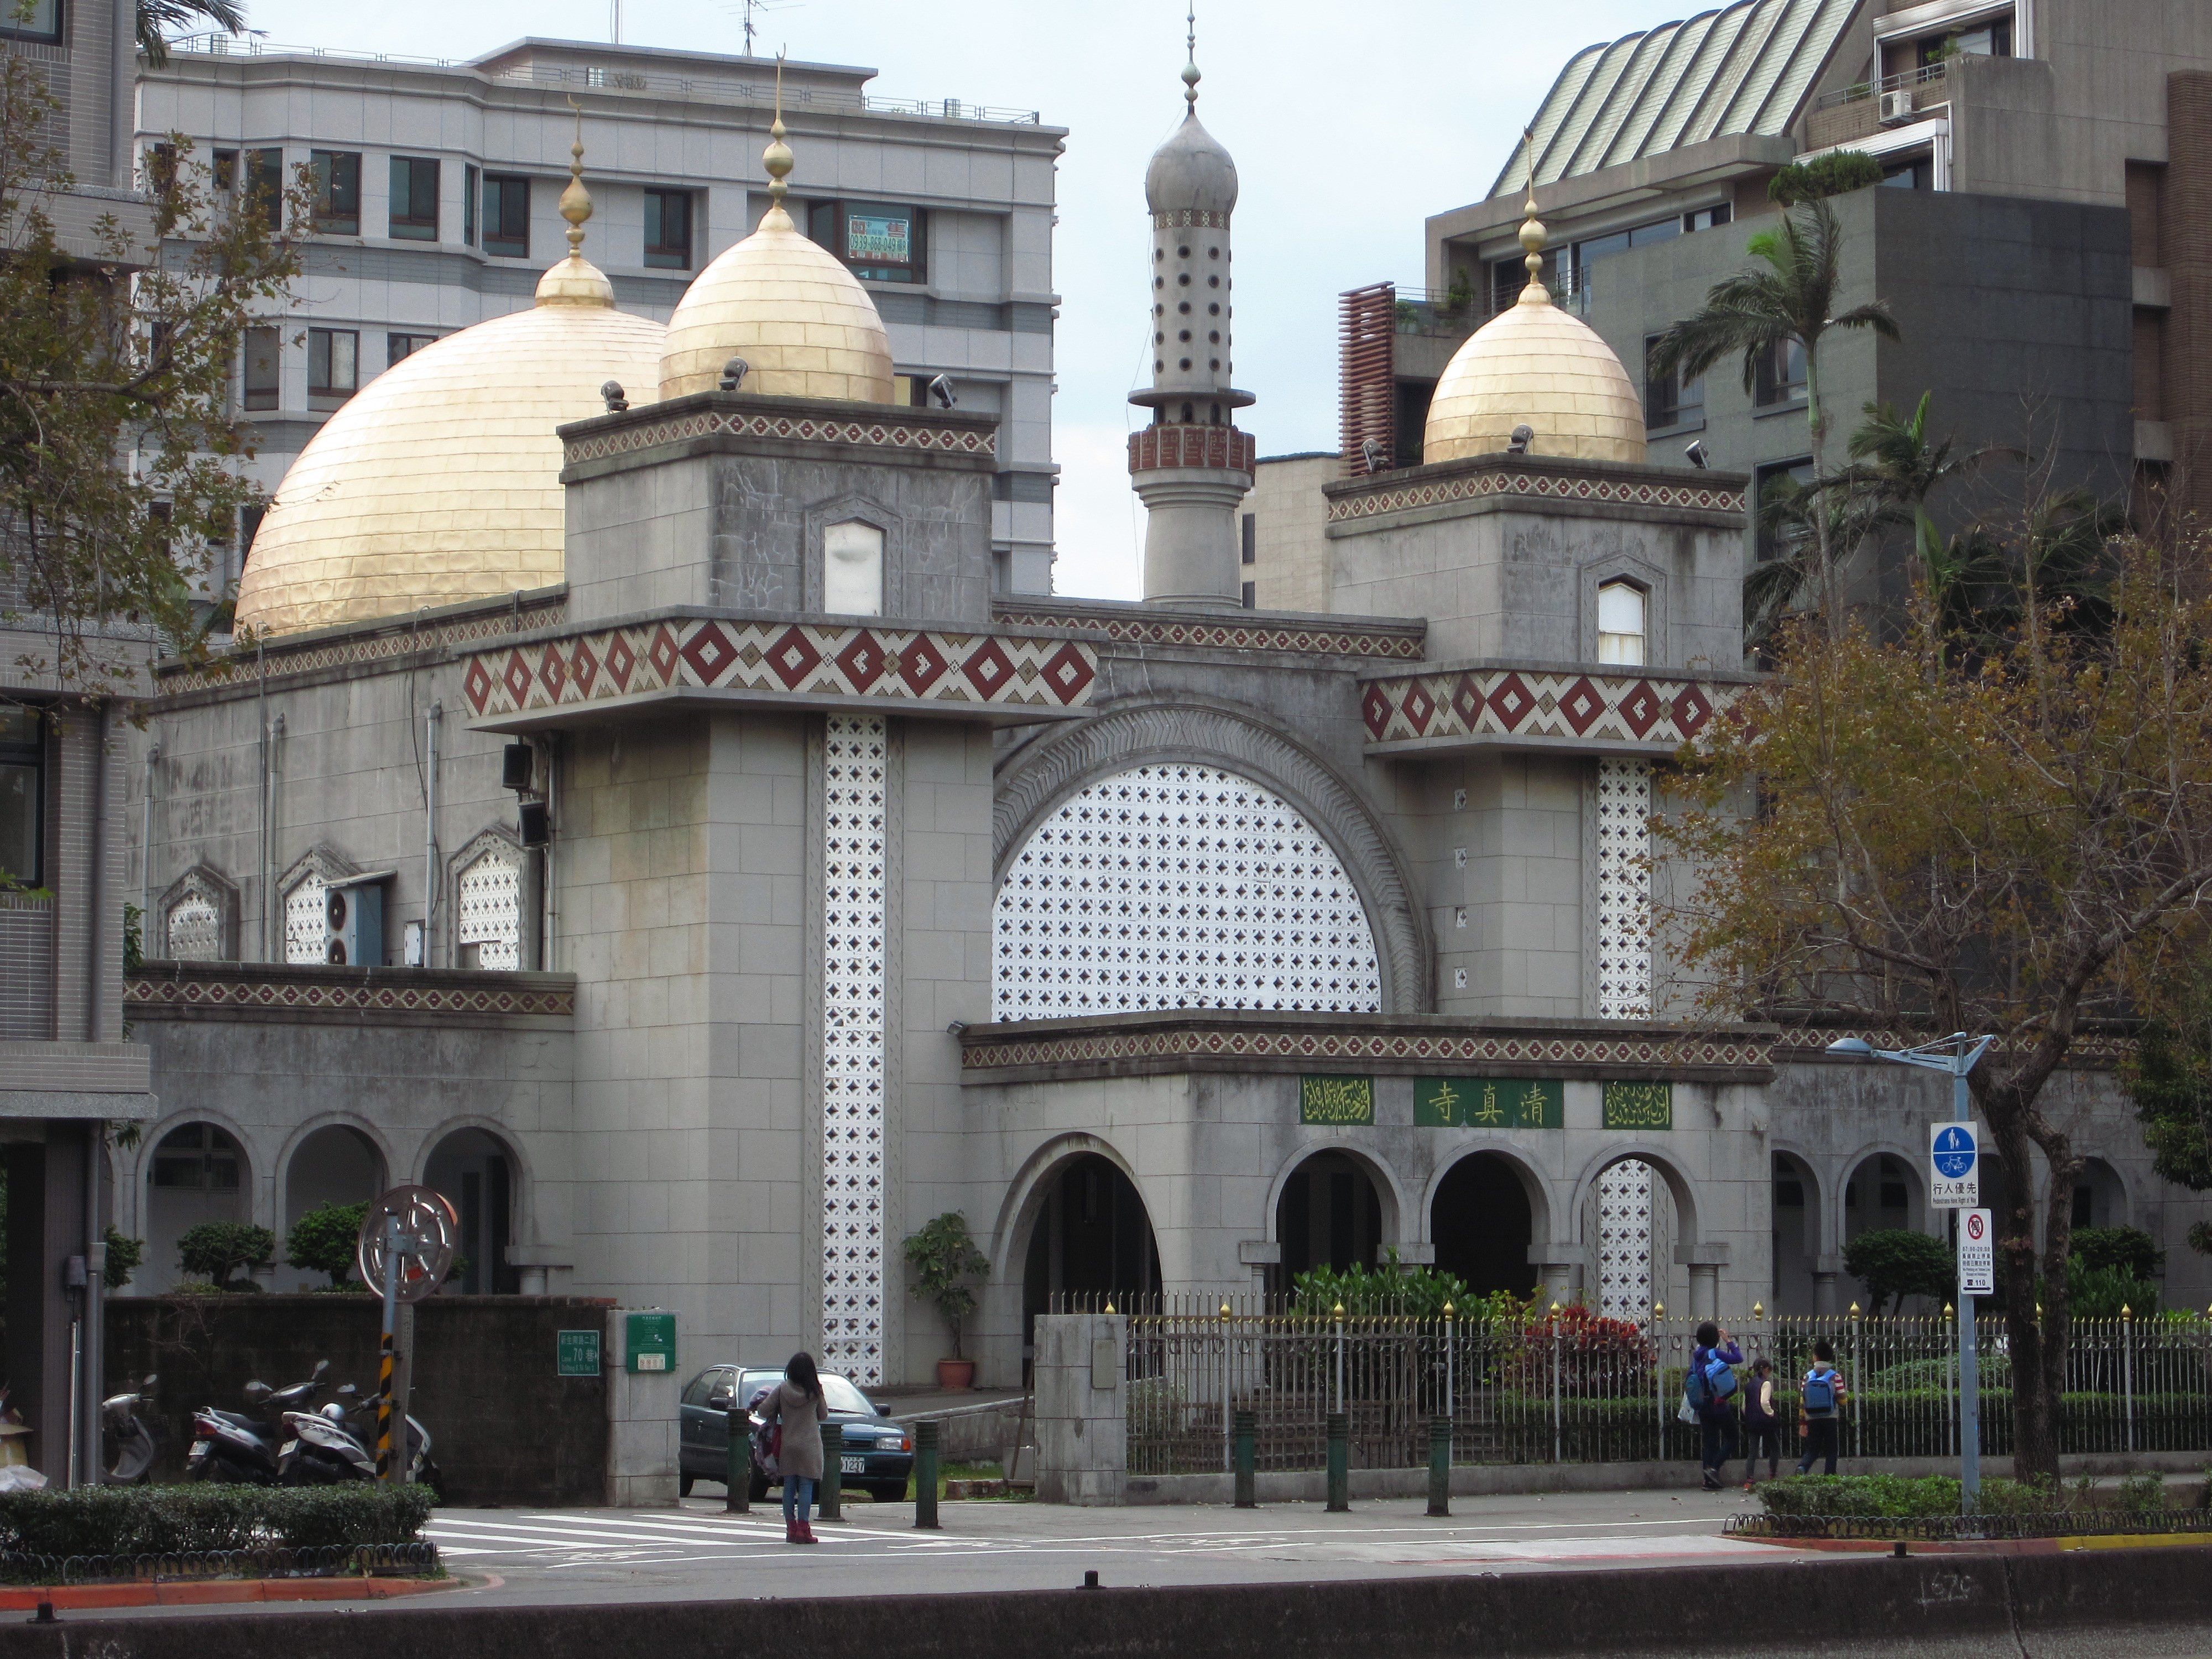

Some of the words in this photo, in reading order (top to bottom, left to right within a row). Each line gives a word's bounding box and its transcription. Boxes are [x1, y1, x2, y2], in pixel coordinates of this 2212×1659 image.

[886, 222, 906, 238] 售
[850, 234, 896, 252] 0939-868-049
[1429, 1081, 1548, 1125] 清真寺
[1933, 1182, 1977, 1194] 行人優先
[573, 1348, 582, 1361] 70
